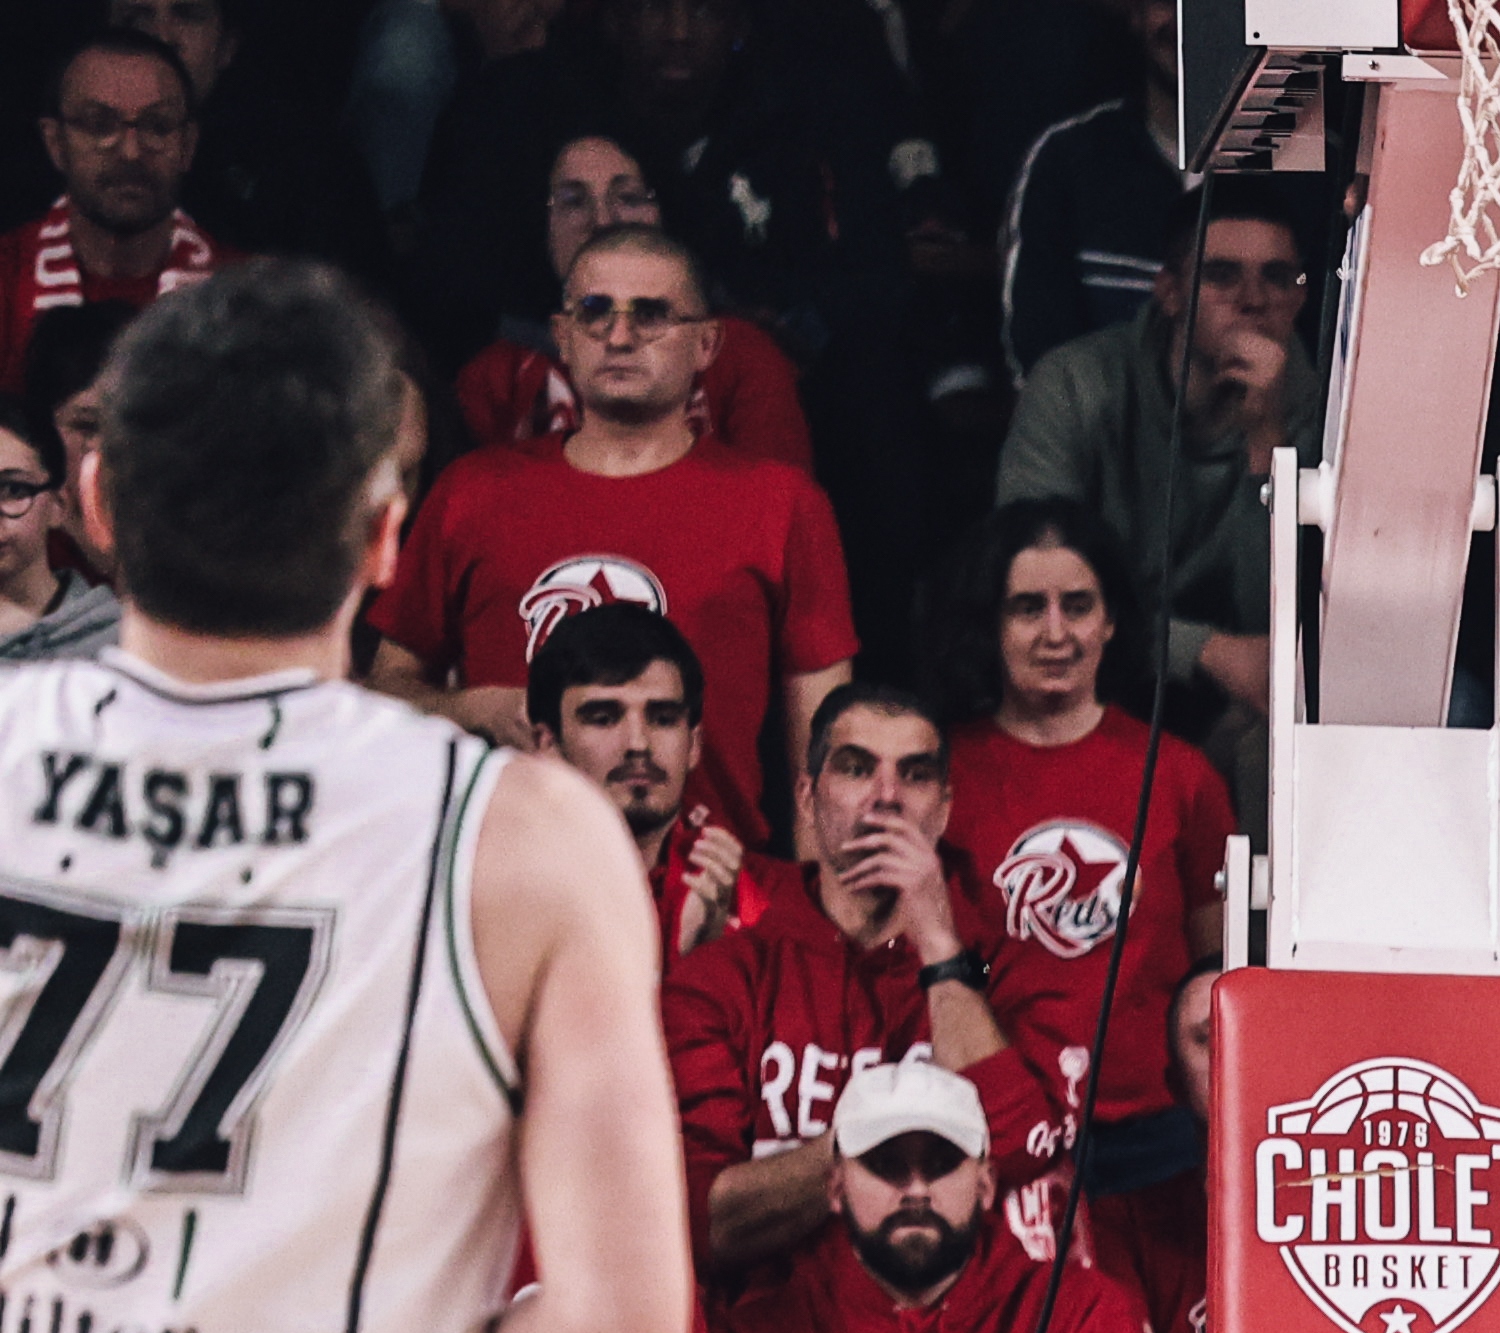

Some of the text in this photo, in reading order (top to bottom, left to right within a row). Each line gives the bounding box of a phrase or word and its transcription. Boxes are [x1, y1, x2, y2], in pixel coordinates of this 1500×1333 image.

[33, 751, 316, 868] YAŞAR
[0, 885, 338, 1193] 77
[1362, 1120, 1430, 1148] 1975
[1322, 1252, 1476, 1291] BASKET
